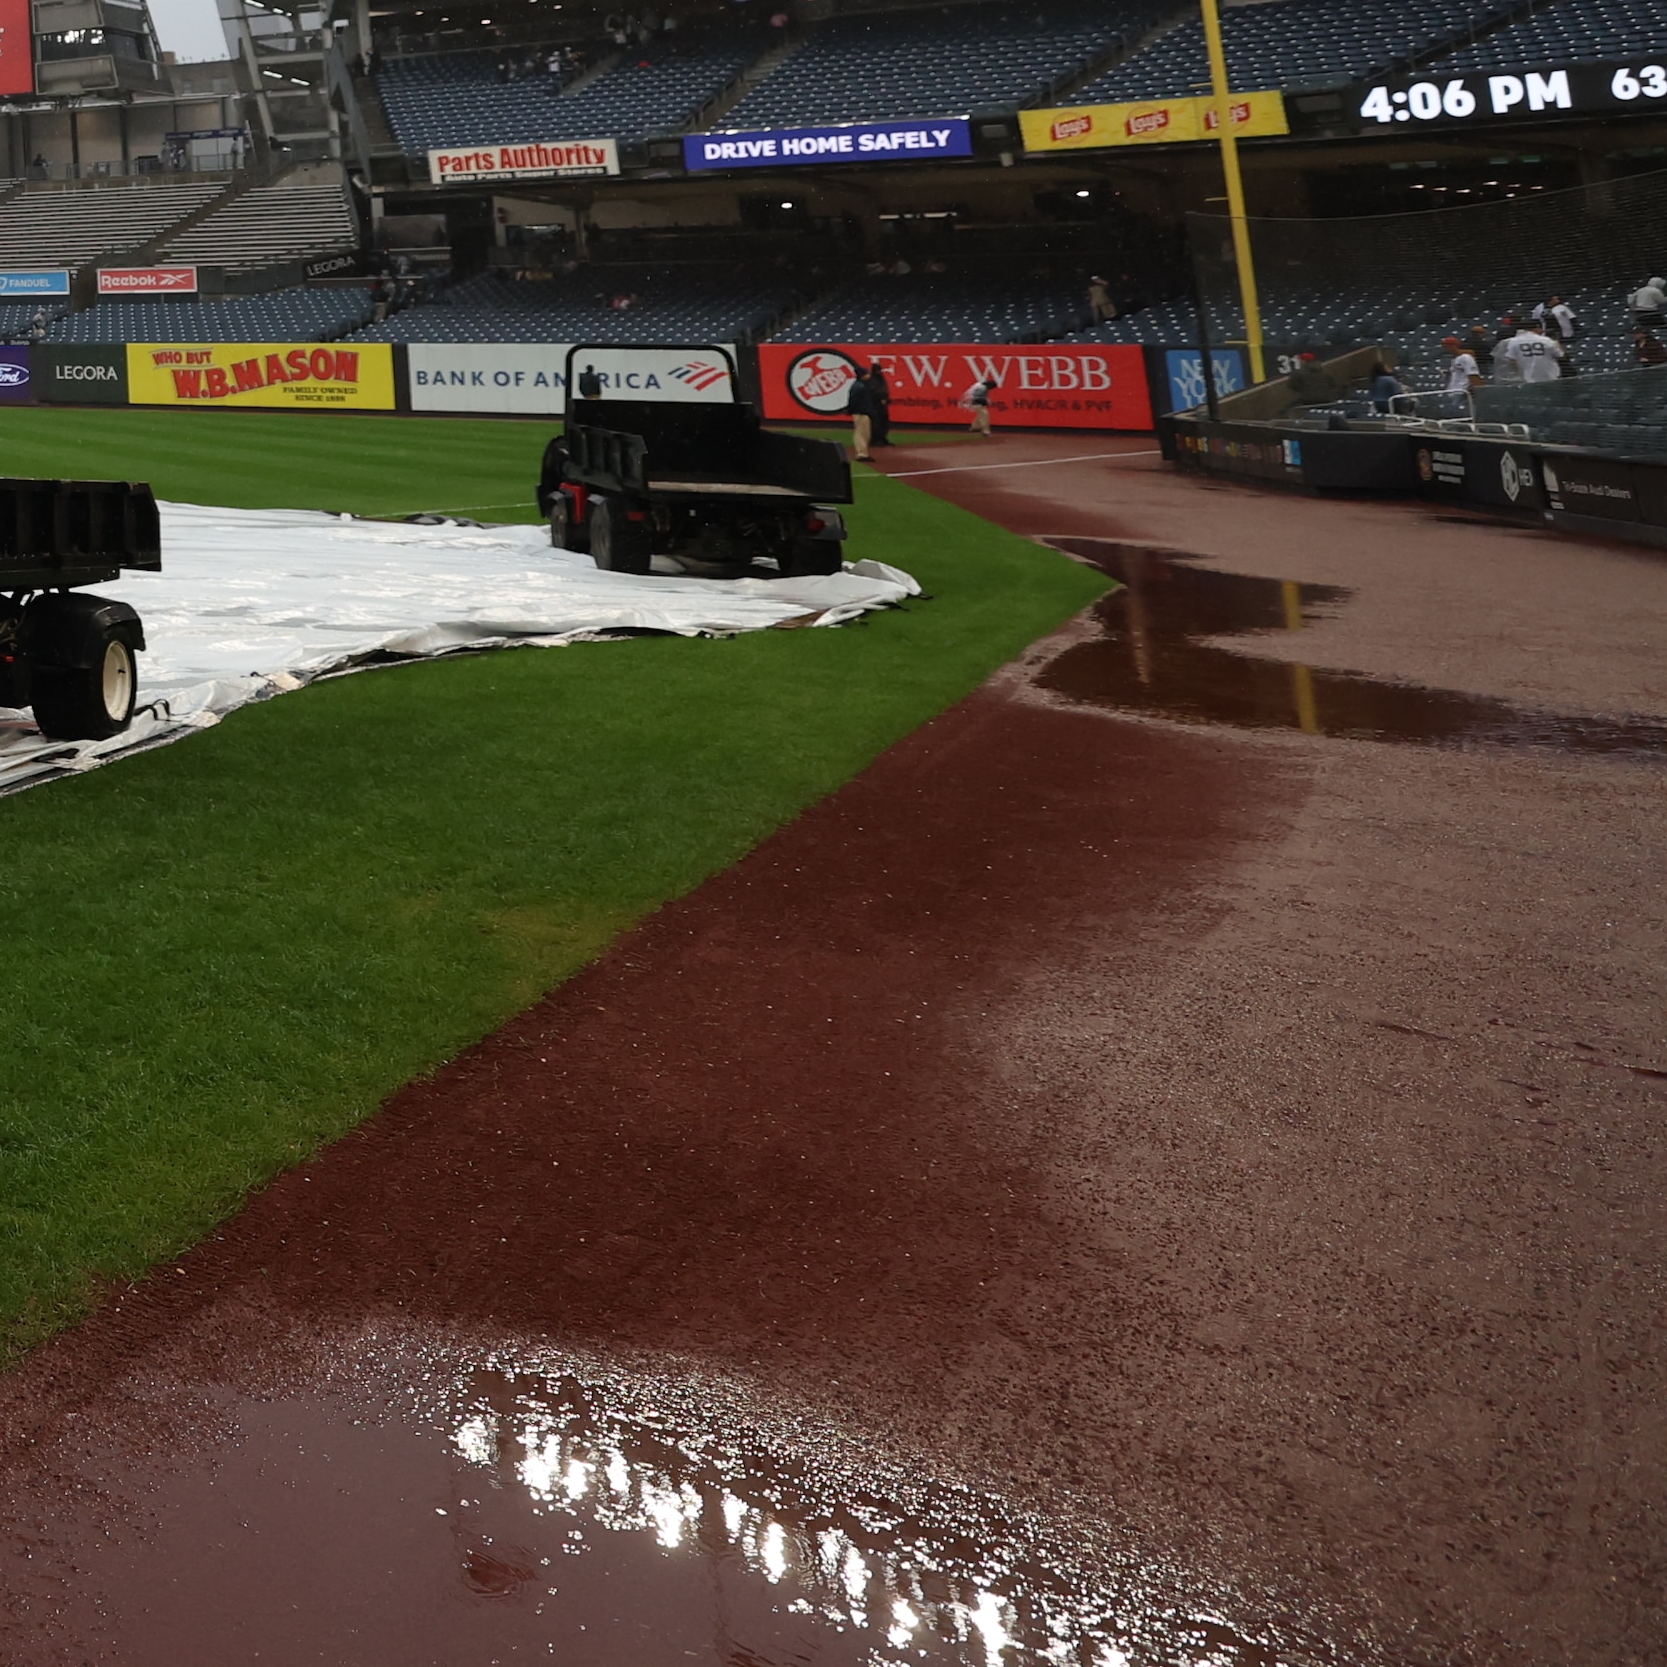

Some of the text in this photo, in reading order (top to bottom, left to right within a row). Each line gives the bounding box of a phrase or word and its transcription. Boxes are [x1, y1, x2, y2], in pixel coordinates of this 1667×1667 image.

[1360, 70, 1573, 123] 4:06 PM
[704, 129, 951, 160] DRIVE HOME SAFELY
[438, 142, 606, 172] Parts Authority
[477, 171, 513, 181] Parts
[306, 256, 355, 276] LEGORA
[9, 278, 51, 288] FANDUEL
[101, 274, 156, 288] Reebok
[152, 350, 212, 365] WHO BUT
[1519, 342, 1545, 357] 99
[56, 365, 118, 381] LEGORA
[172, 348, 359, 398] W.B.MASON
[417, 370, 662, 390] BANK OF AMRICA
[868, 355, 1112, 391] F.W. WEBB
